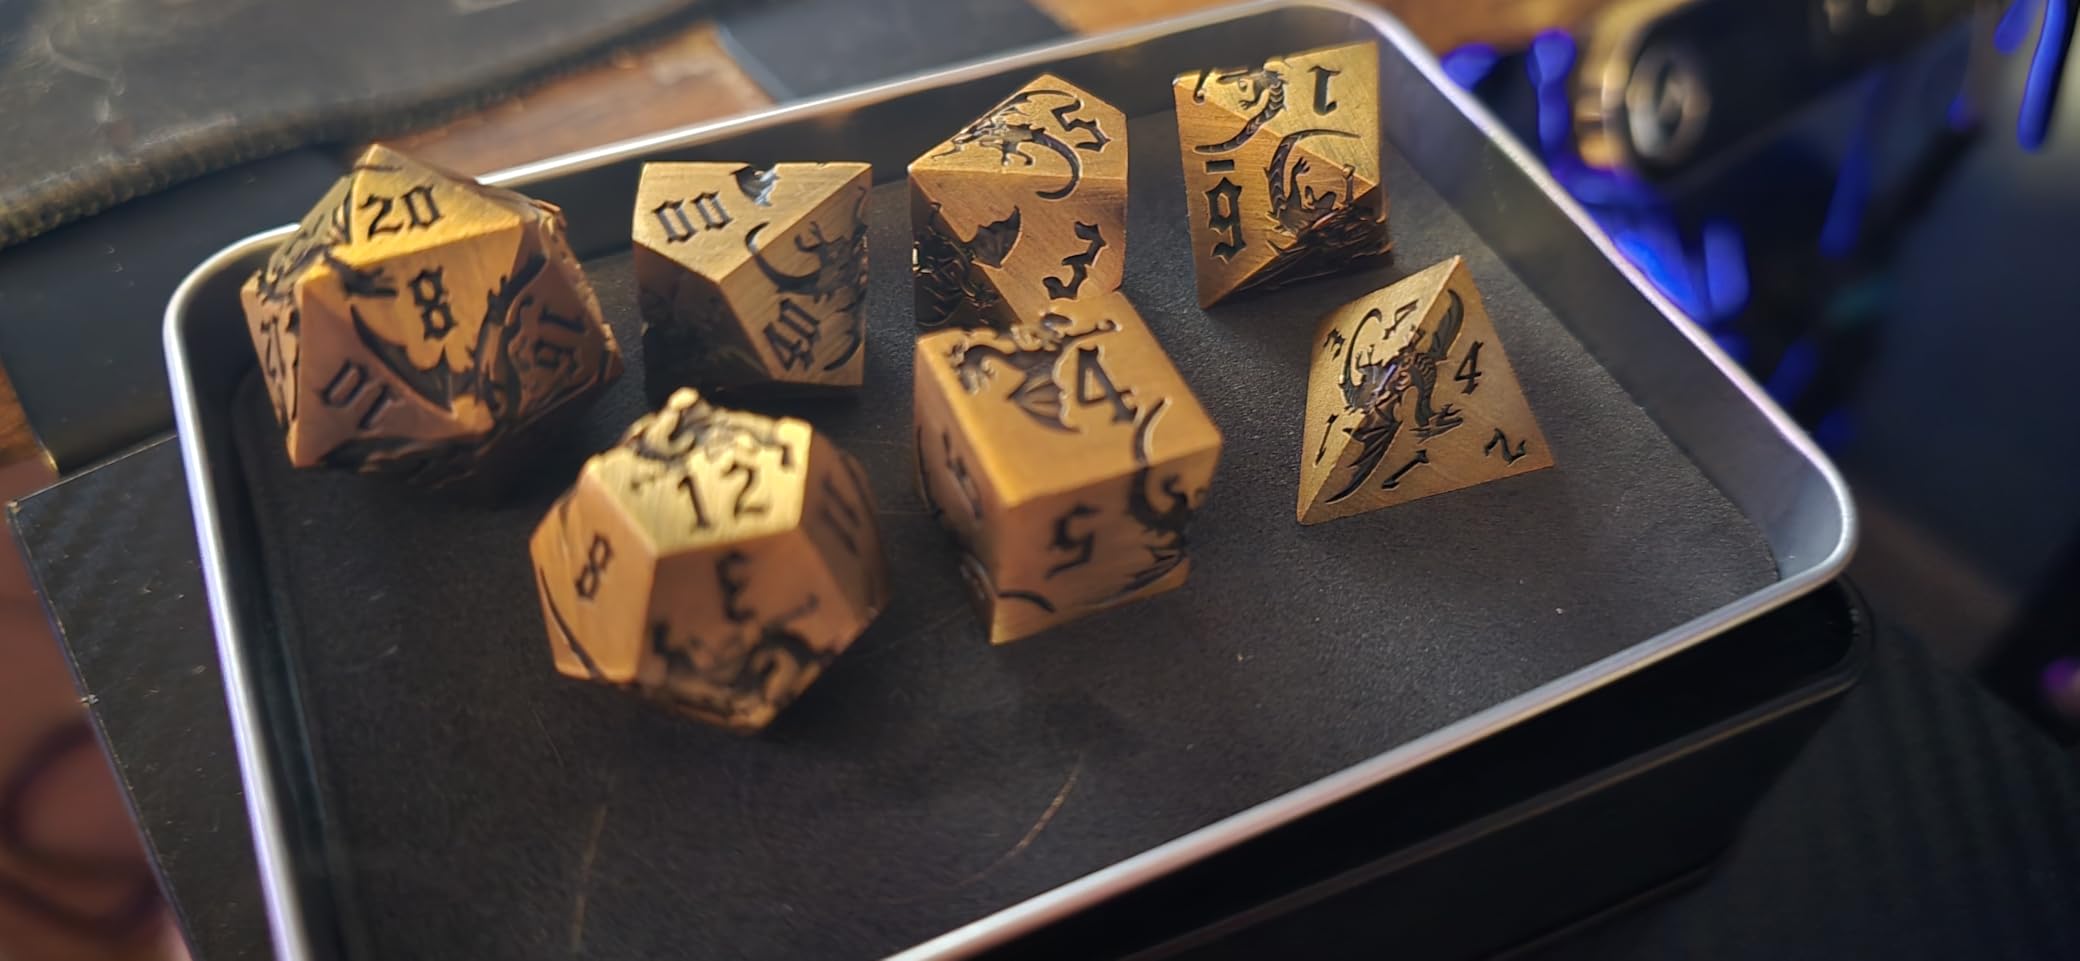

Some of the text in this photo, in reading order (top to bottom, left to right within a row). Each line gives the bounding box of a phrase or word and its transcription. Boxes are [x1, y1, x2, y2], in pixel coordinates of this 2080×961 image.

[1307, 65, 1343, 117] 1
[1050, 98, 1112, 153] 5
[359, 183, 444, 240] 20
[651, 191, 733, 245] 00
[1042, 220, 1107, 301] 3
[408, 264, 457, 341] 8
[762, 299, 821, 372] 40
[1077, 346, 1142, 426] 4
[1454, 340, 1484, 396] 4
[1381, 449, 1430, 490] 1
[1483, 427, 1527, 466] 2
[677, 458, 769, 531] 12
[575, 533, 613, 603] 8
[1044, 503, 1103, 580] 5
